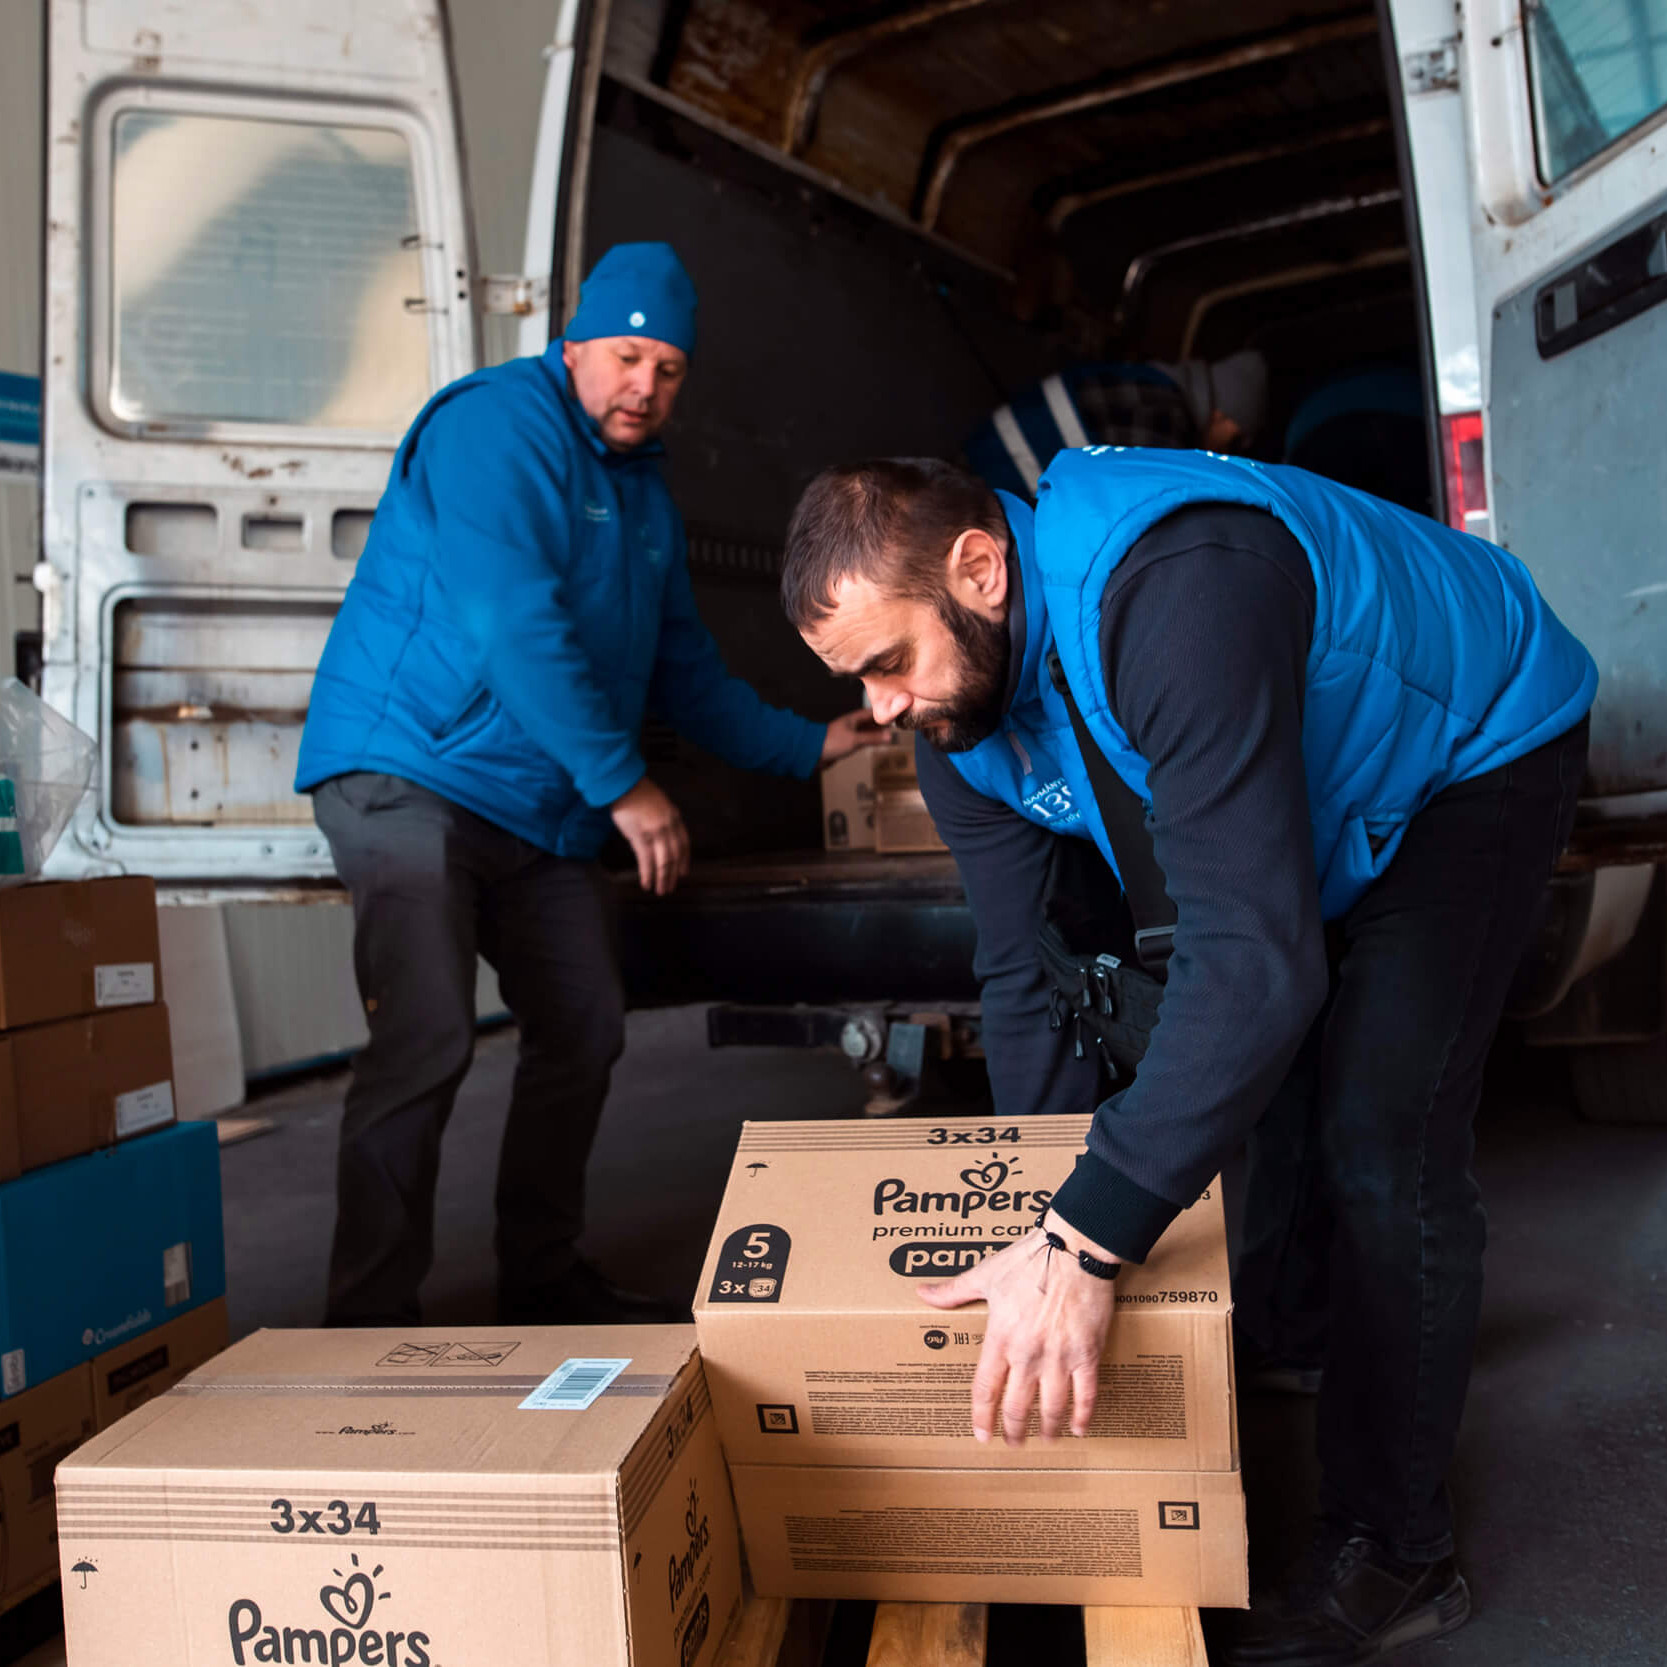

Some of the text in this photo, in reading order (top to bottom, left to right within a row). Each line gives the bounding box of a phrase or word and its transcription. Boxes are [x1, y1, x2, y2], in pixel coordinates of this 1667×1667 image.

[927, 1127, 1021, 1144] 3x34
[874, 1178, 1053, 1219] Pampers
[743, 1232, 771, 1259] 5
[873, 1223, 1034, 1241] premium car
[732, 1261, 773, 1270] 12-17 kg
[904, 1245, 999, 1273] pant
[718, 1280, 745, 1294] 3x
[666, 1394, 694, 1460] 3x34
[270, 1498, 381, 1536] 3x34
[668, 1515, 710, 1613] Pampers
[229, 1599, 430, 1667] Pampers
